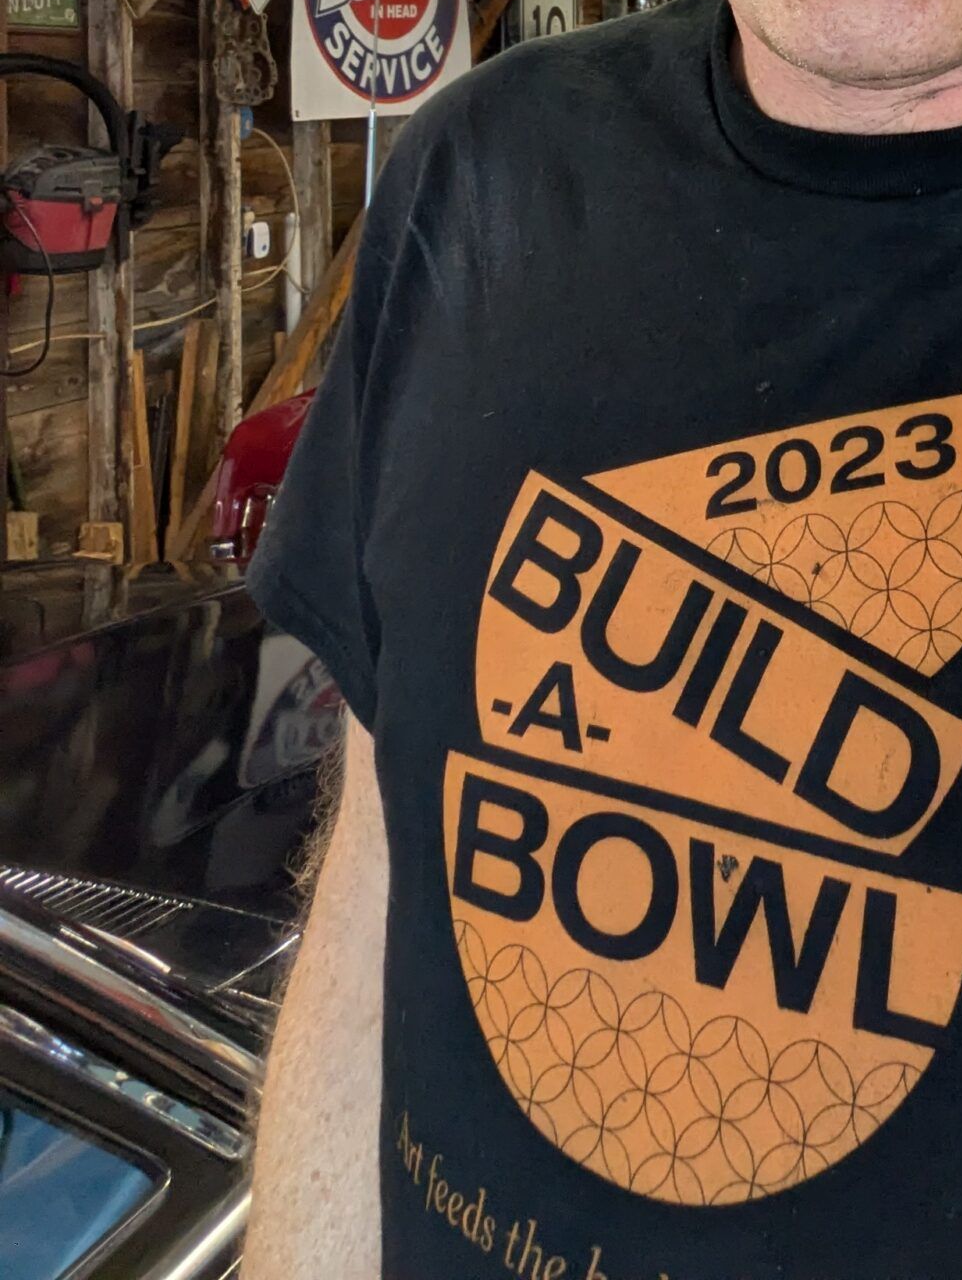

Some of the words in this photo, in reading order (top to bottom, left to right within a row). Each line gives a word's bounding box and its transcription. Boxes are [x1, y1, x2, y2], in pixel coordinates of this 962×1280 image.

[324, 21, 445, 94] SERVICE
[386, 4, 418, 19] HEAD
[532, 4, 567, 38] 10
[705, 413, 957, 520] 2023
[487, 488, 942, 840] BUILD
[452, 771, 949, 1051] BOWL
[397, 1111, 423, 1185] Art
[425, 1153, 496, 1253] feeds
[504, 1219, 567, 1280] the
